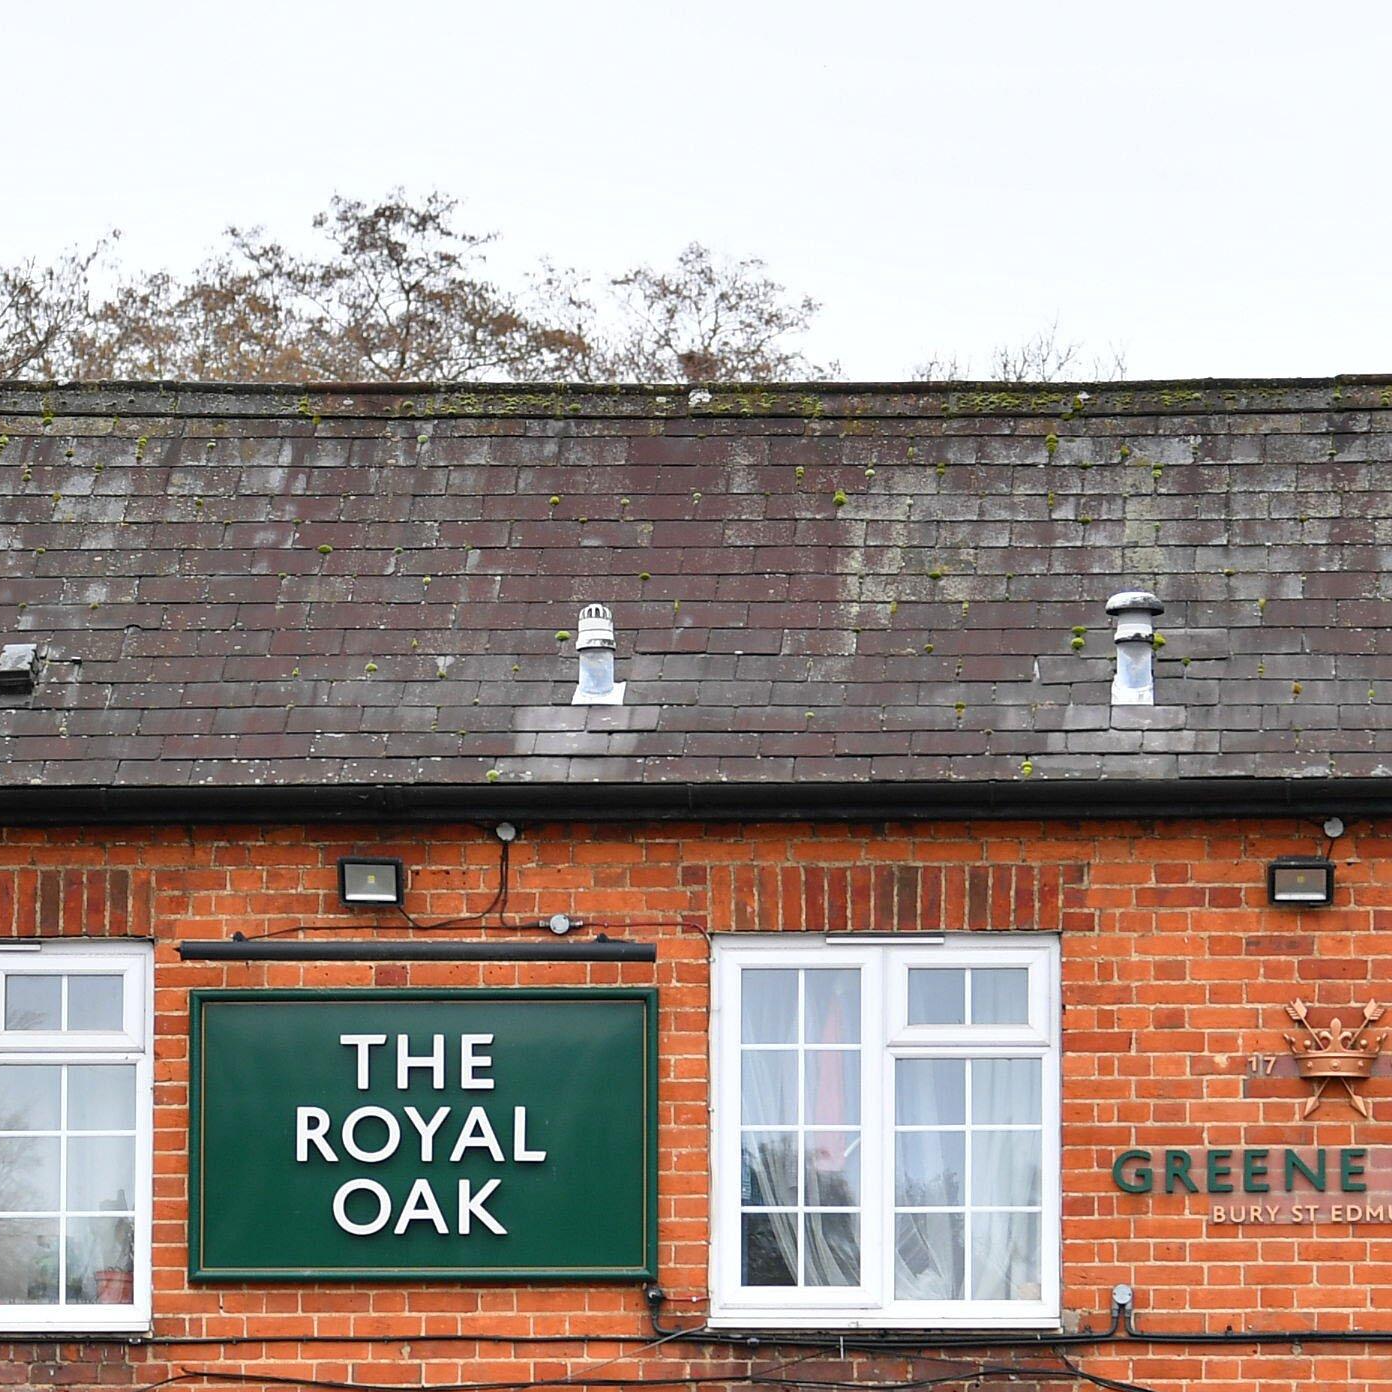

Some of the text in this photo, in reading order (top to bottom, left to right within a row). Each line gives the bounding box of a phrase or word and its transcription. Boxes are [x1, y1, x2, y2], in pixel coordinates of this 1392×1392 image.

[339, 1033, 495, 1090] THE
[1248, 1054, 1277, 1076] 17
[296, 1106, 547, 1163] ROYAL
[1112, 1148, 1367, 1194] GREENE
[332, 1178, 508, 1236] OAK
[1212, 1205, 1280, 1224] BURY
[1292, 1205, 1319, 1223] ST
